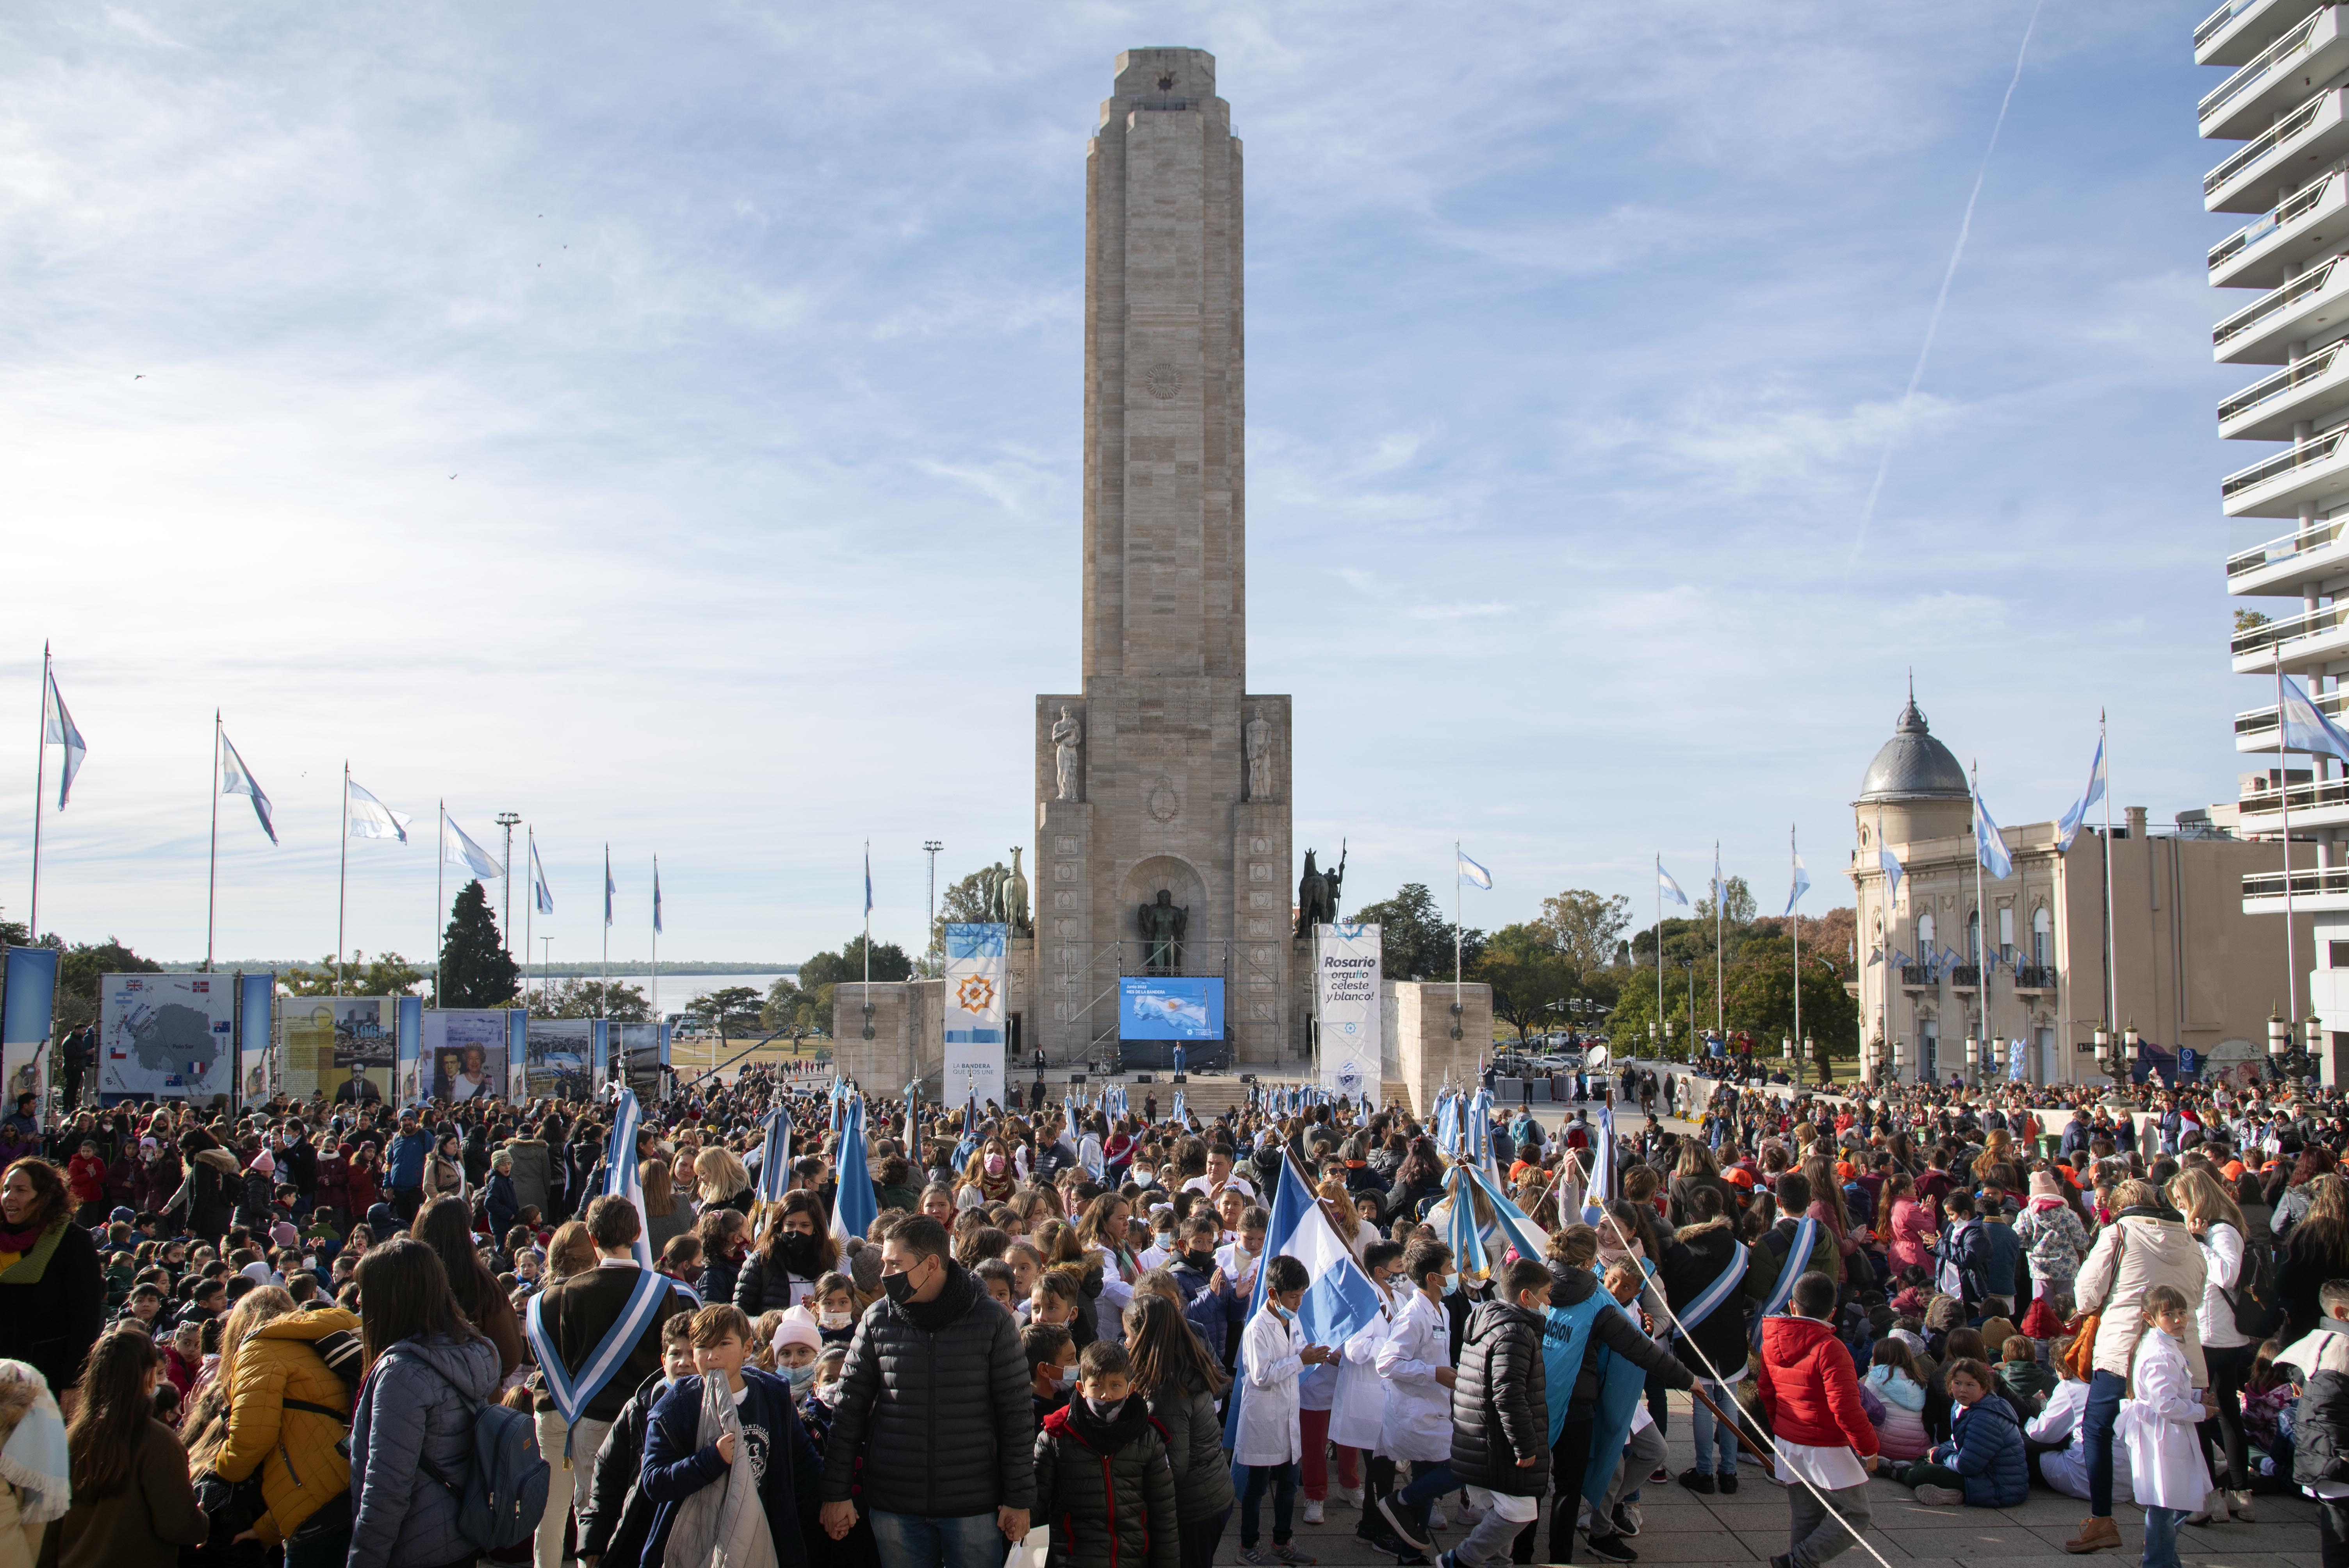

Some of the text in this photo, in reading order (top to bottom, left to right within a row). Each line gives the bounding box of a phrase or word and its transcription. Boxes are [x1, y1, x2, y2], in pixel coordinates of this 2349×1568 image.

[1324, 956, 1376, 968] Rosario
[1331, 970, 1369, 981] orgullo
[1331, 980, 1369, 989] celeste
[1326, 991, 1374, 1003] y blanco!
[140, 1016, 152, 1028] REINO
[142, 1019, 155, 1033] UNIDO
[352, 1025, 387, 1038] 1965
